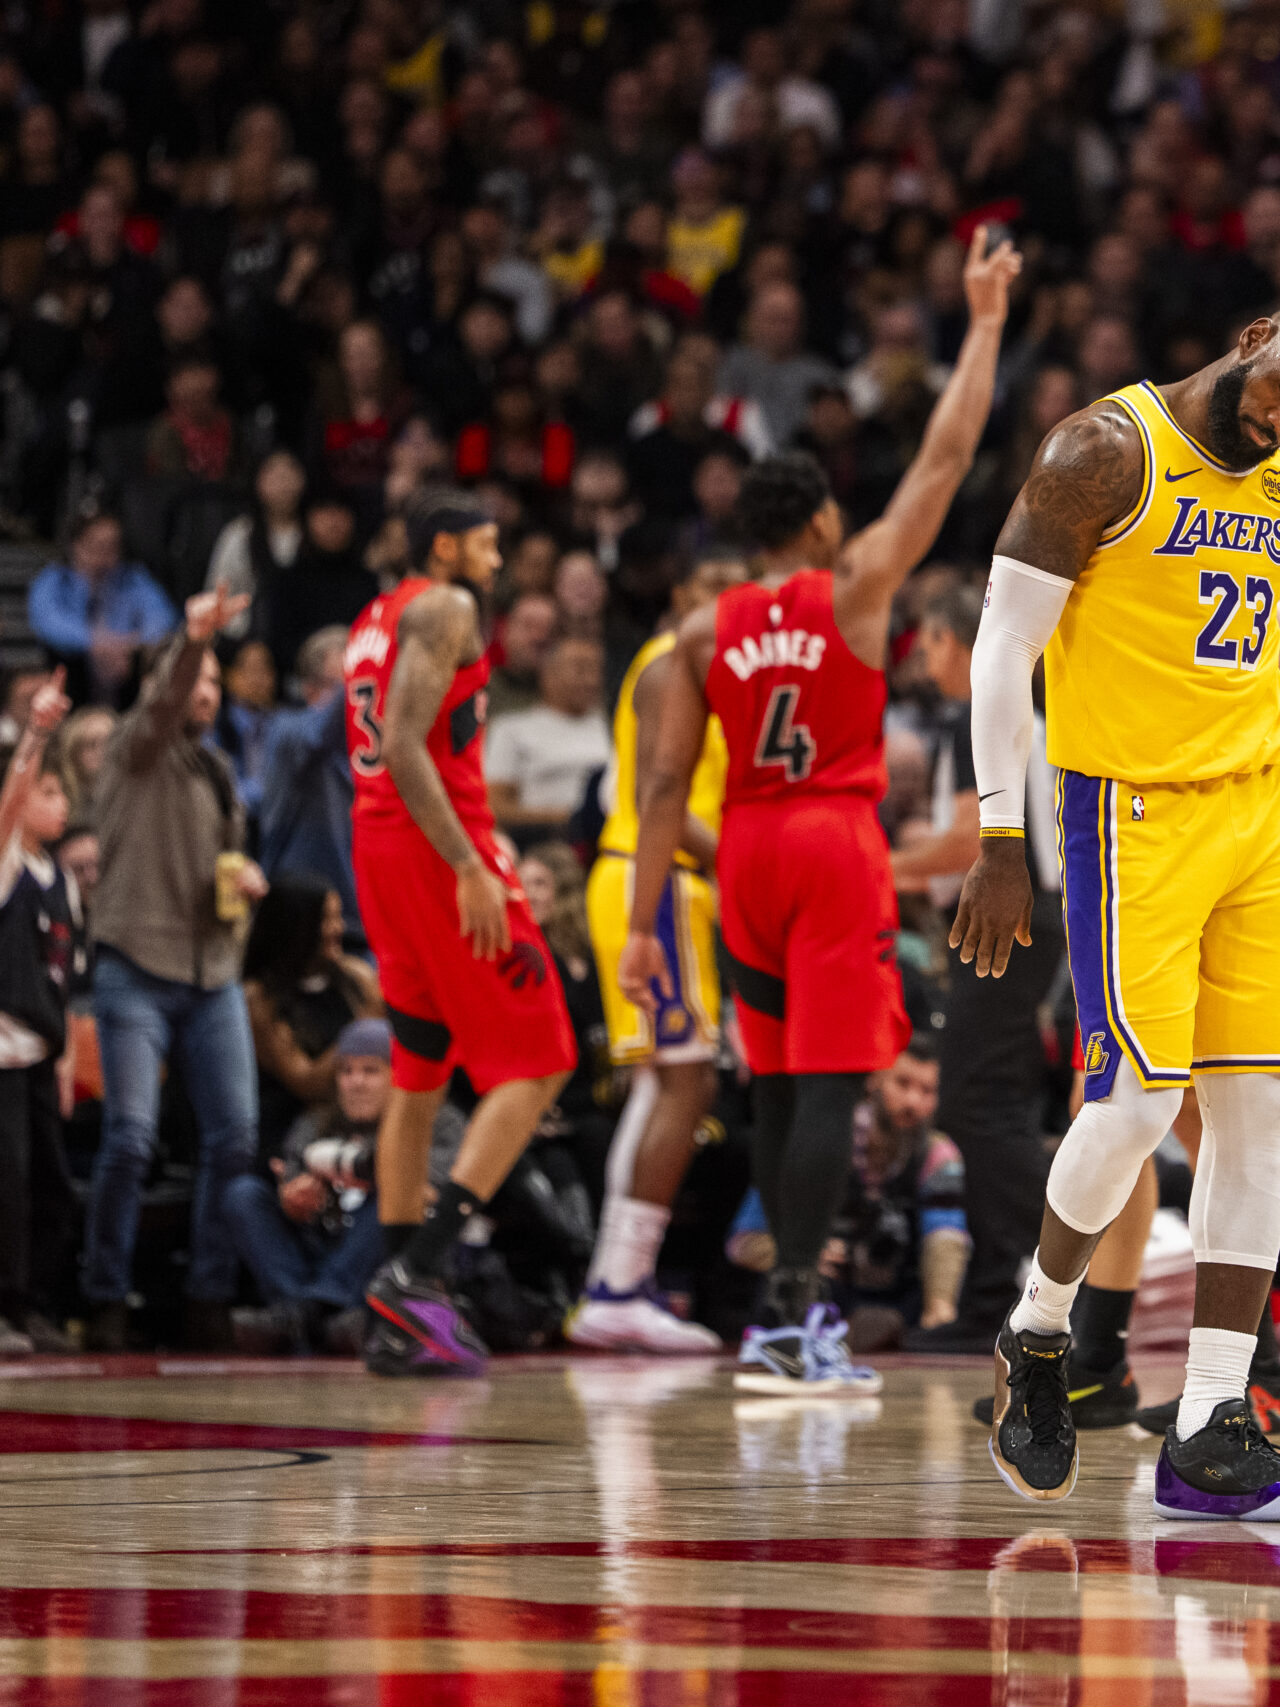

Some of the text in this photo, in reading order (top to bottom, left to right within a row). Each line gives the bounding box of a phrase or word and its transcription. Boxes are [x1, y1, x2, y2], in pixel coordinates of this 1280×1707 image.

[1194, 569, 1274, 672] 23
[350, 675, 387, 777] 3
[753, 683, 817, 783] 4
